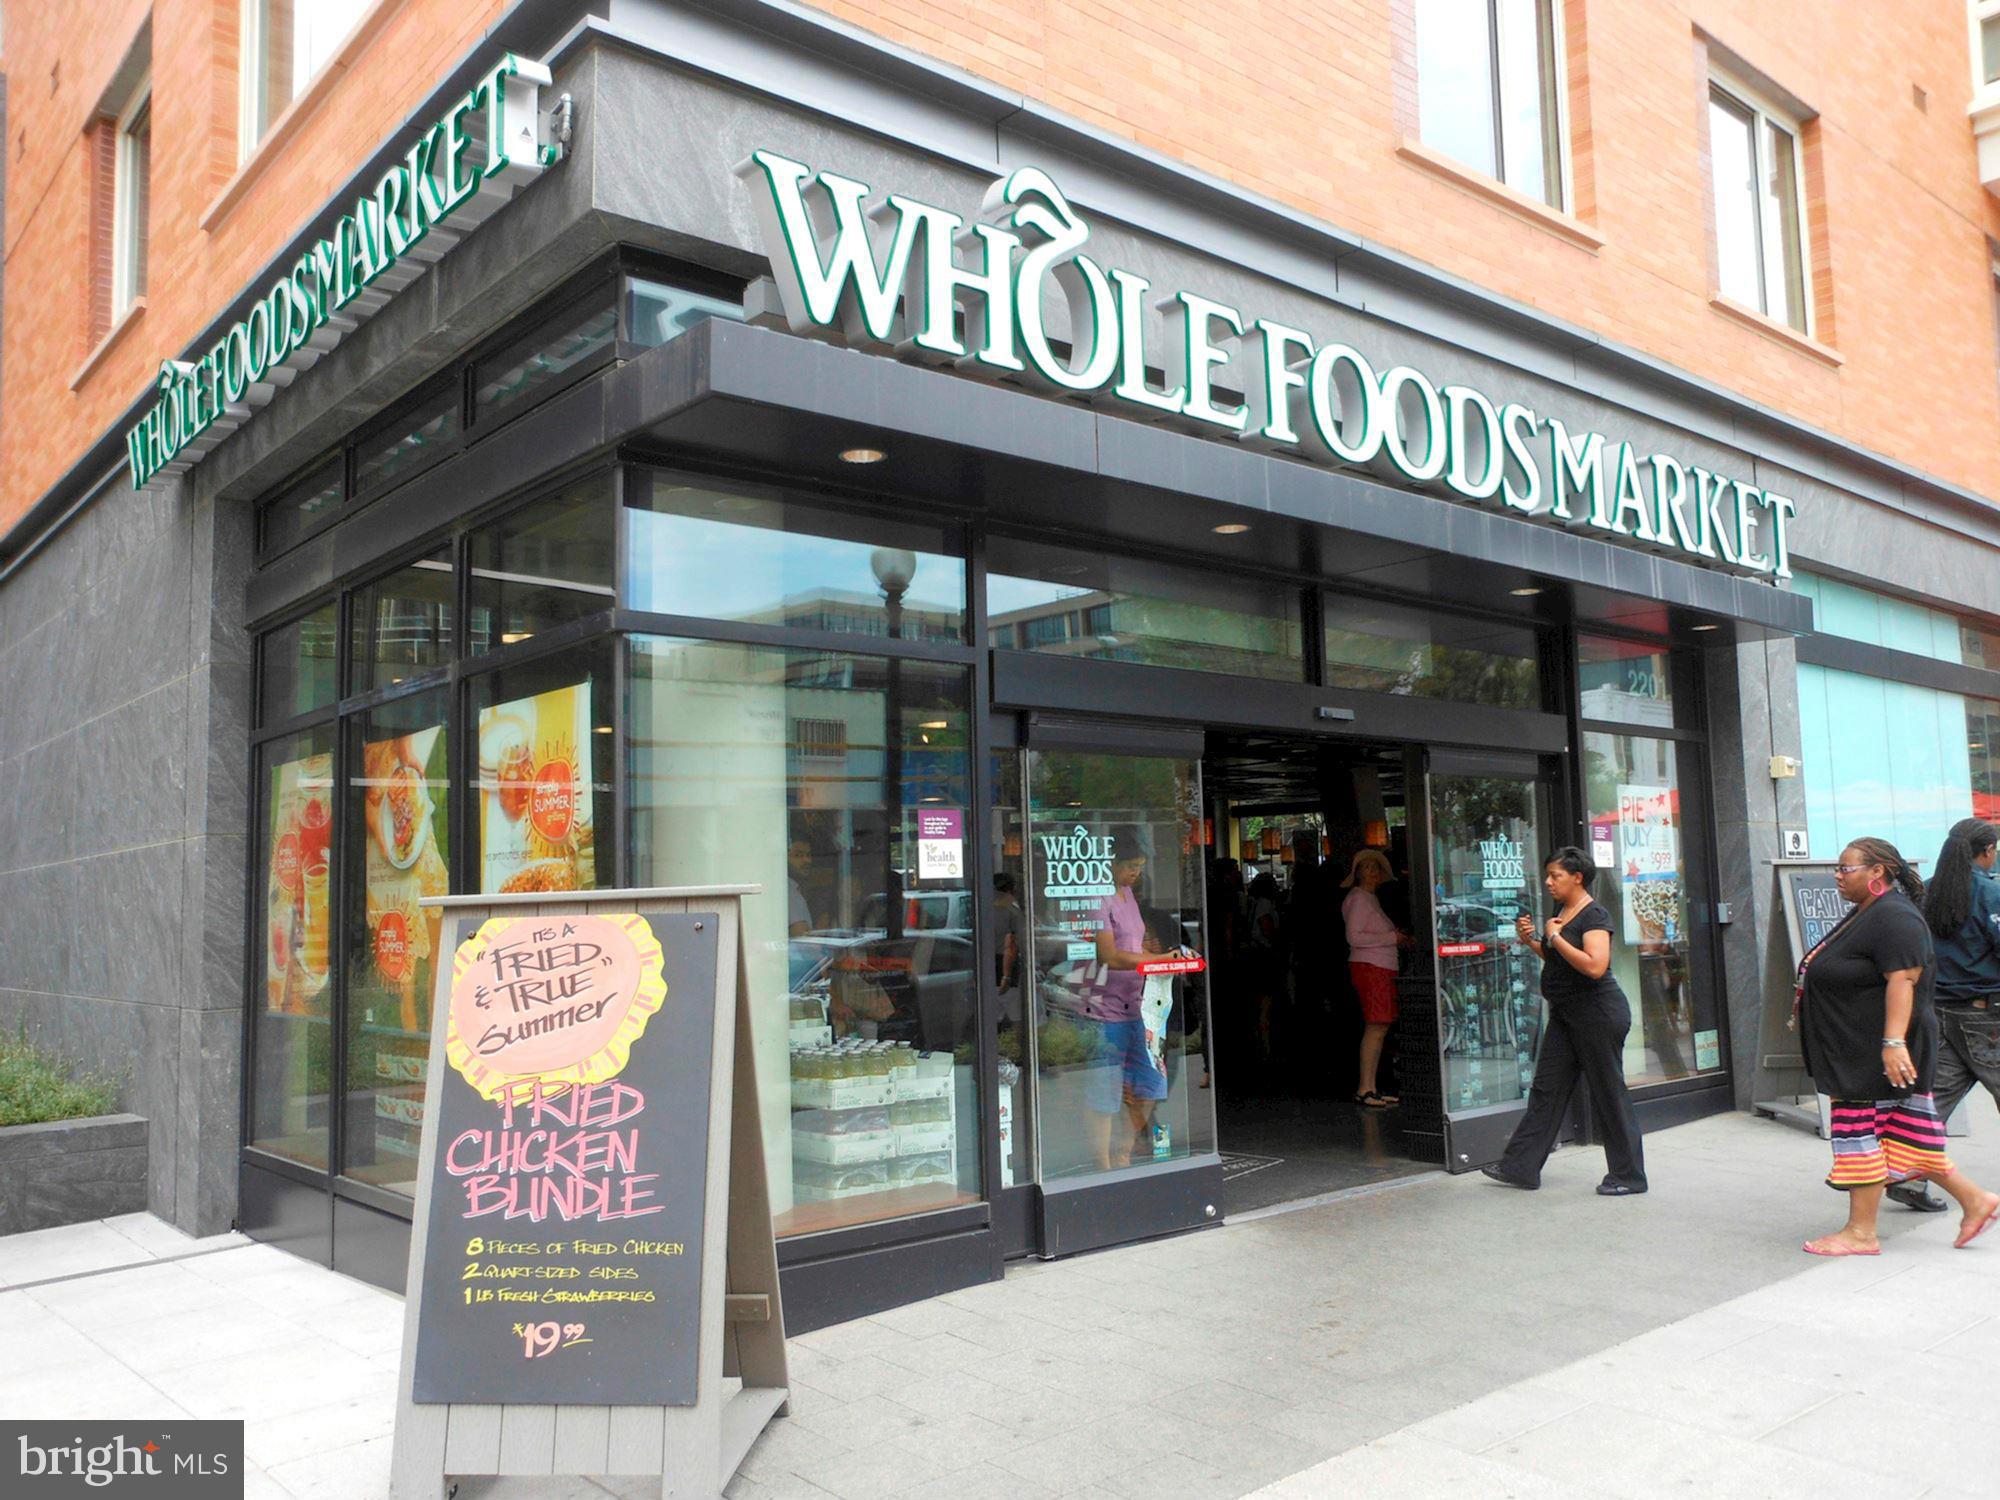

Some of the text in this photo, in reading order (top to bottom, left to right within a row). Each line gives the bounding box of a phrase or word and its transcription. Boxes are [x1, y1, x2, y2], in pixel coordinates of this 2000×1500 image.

[209, 252, 317, 419] FOODS
[313, 51, 519, 329] MARKET
[750, 148, 1796, 580] WHOLE FOODS MARKET
[1628, 669, 1667, 700] 2201
[534, 794, 571, 813] SUMMER
[1621, 795, 1645, 824] PIE
[1040, 824, 1116, 860] WHOLE
[1480, 832, 1525, 860] WHOLE
[1622, 825, 1652, 856] JULY
[1045, 860, 1115, 885] FOODS
[1483, 860, 1523, 879] FOODS
[562, 922, 579, 938] A
[493, 966, 598, 1015] TRUE
[475, 991, 619, 1056] Summer
[490, 1076, 646, 1129] FRIED
[446, 1128, 640, 1178] CHICKEN
[462, 1173, 666, 1223] BUNDLE
[466, 1237, 685, 1256] 8 PIECES OF FRIED CHICKEN
[462, 1262, 483, 1280] 2
[588, 1265, 640, 1280] SIDES
[464, 1287, 656, 1305] 1 LB FRESH STRAWBERRIES
